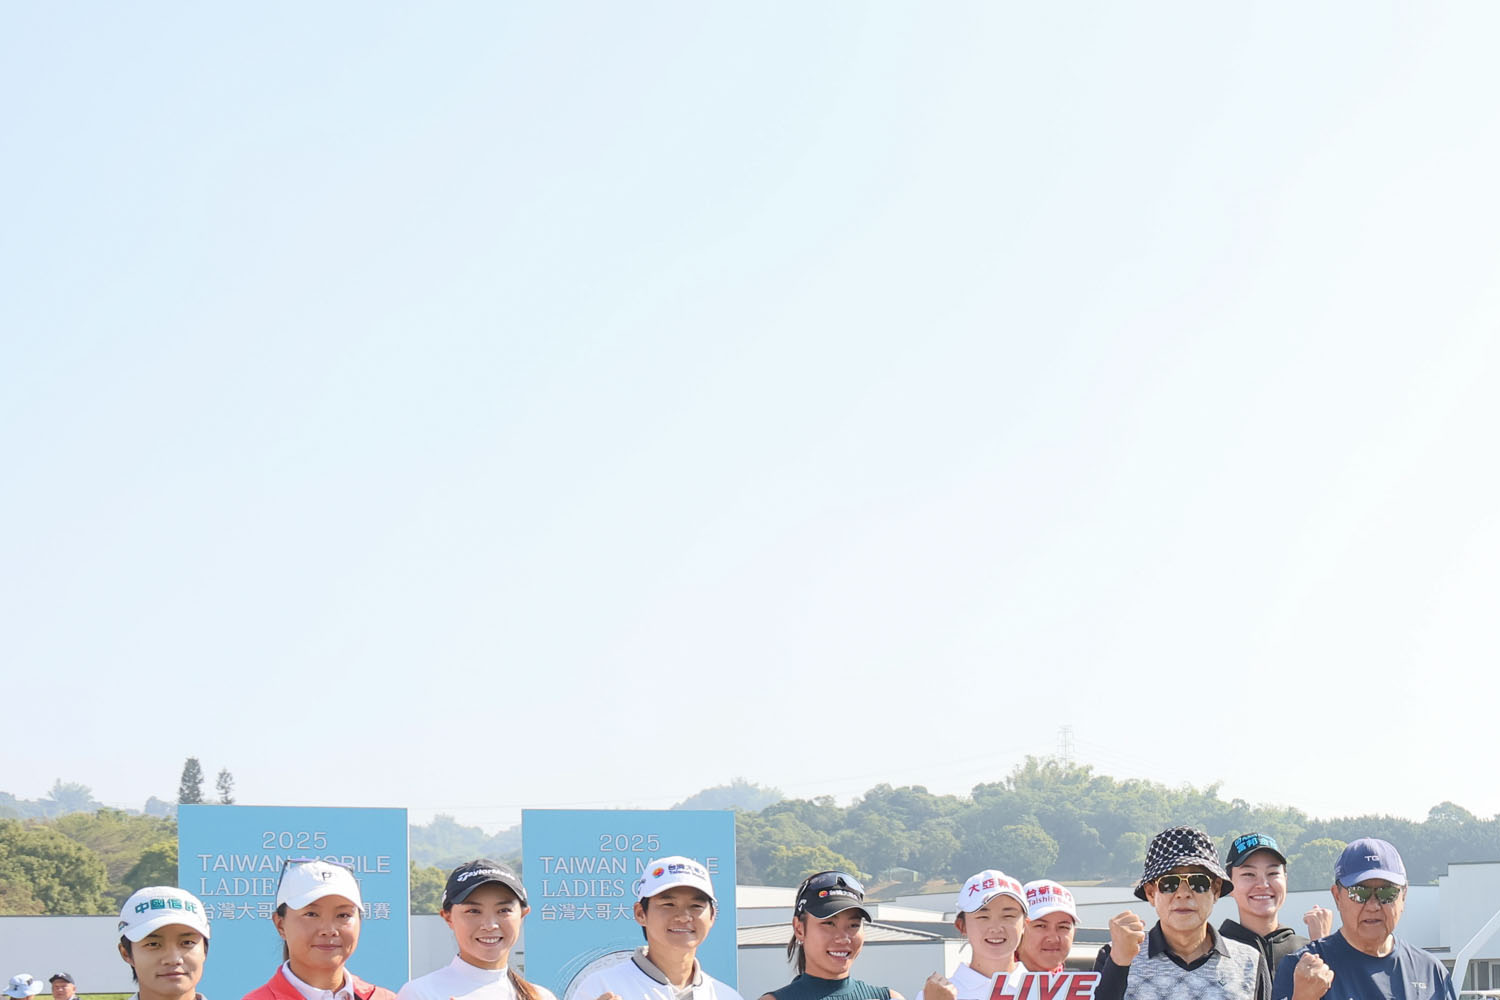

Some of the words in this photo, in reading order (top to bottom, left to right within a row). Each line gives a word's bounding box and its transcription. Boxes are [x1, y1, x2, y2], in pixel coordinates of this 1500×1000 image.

[262, 831, 327, 849] 2025
[600, 834, 660, 852] 2025
[197, 854, 290, 873] TAIWAN
[539, 856, 627, 874] TAIWAN
[457, 869, 516, 882] TaylorMade
[200, 877, 280, 897] LADIE
[541, 879, 625, 897] LADIES
[135, 898, 198, 914] 中國信託
